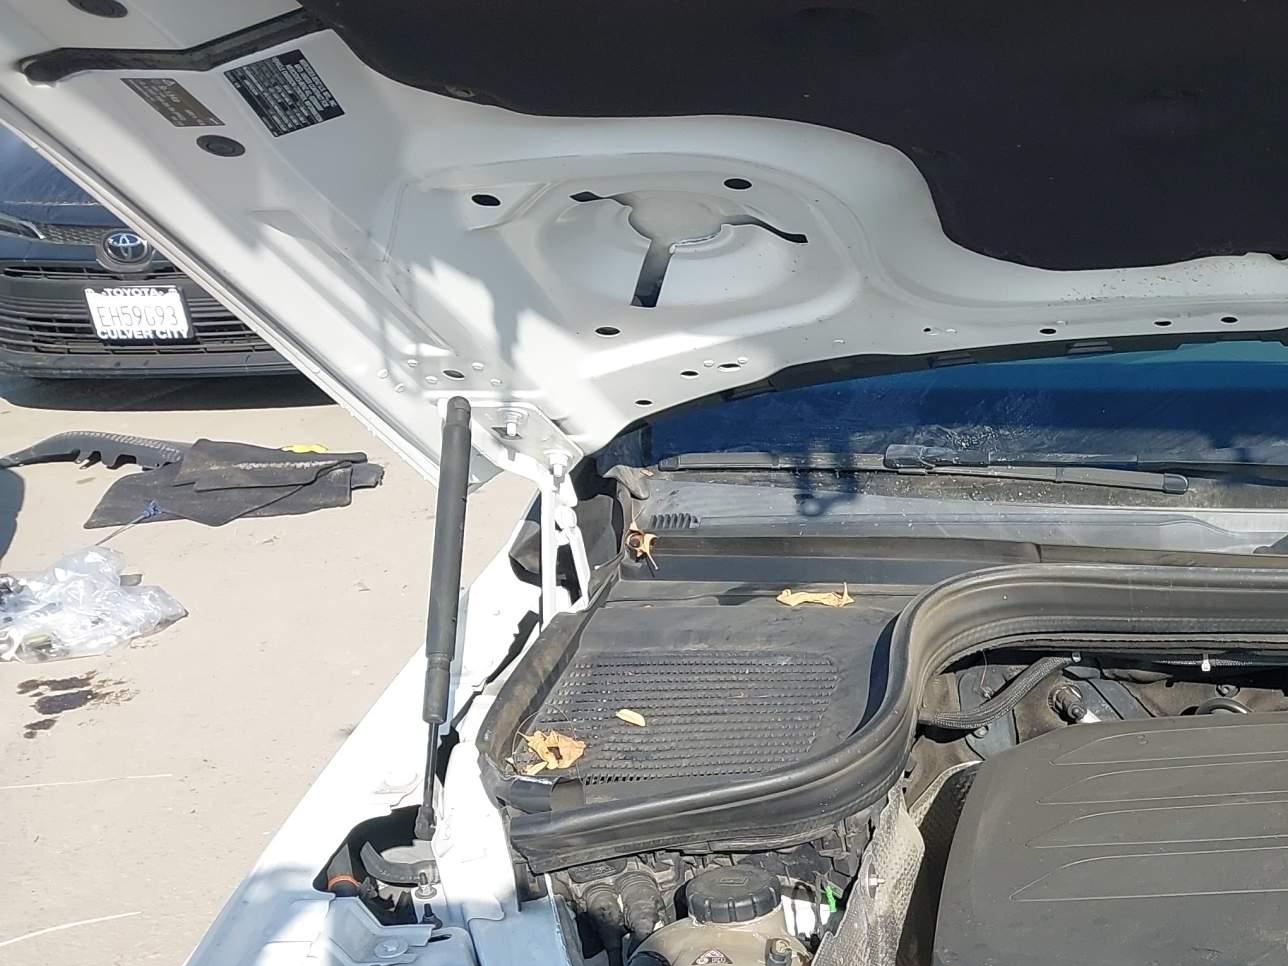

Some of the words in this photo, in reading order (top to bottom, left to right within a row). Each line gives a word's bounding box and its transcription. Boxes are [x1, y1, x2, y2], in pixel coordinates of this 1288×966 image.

[103, 288, 159, 297] TOYOTA
[100, 329, 154, 339] CULVER
[155, 329, 188, 339] CITY
